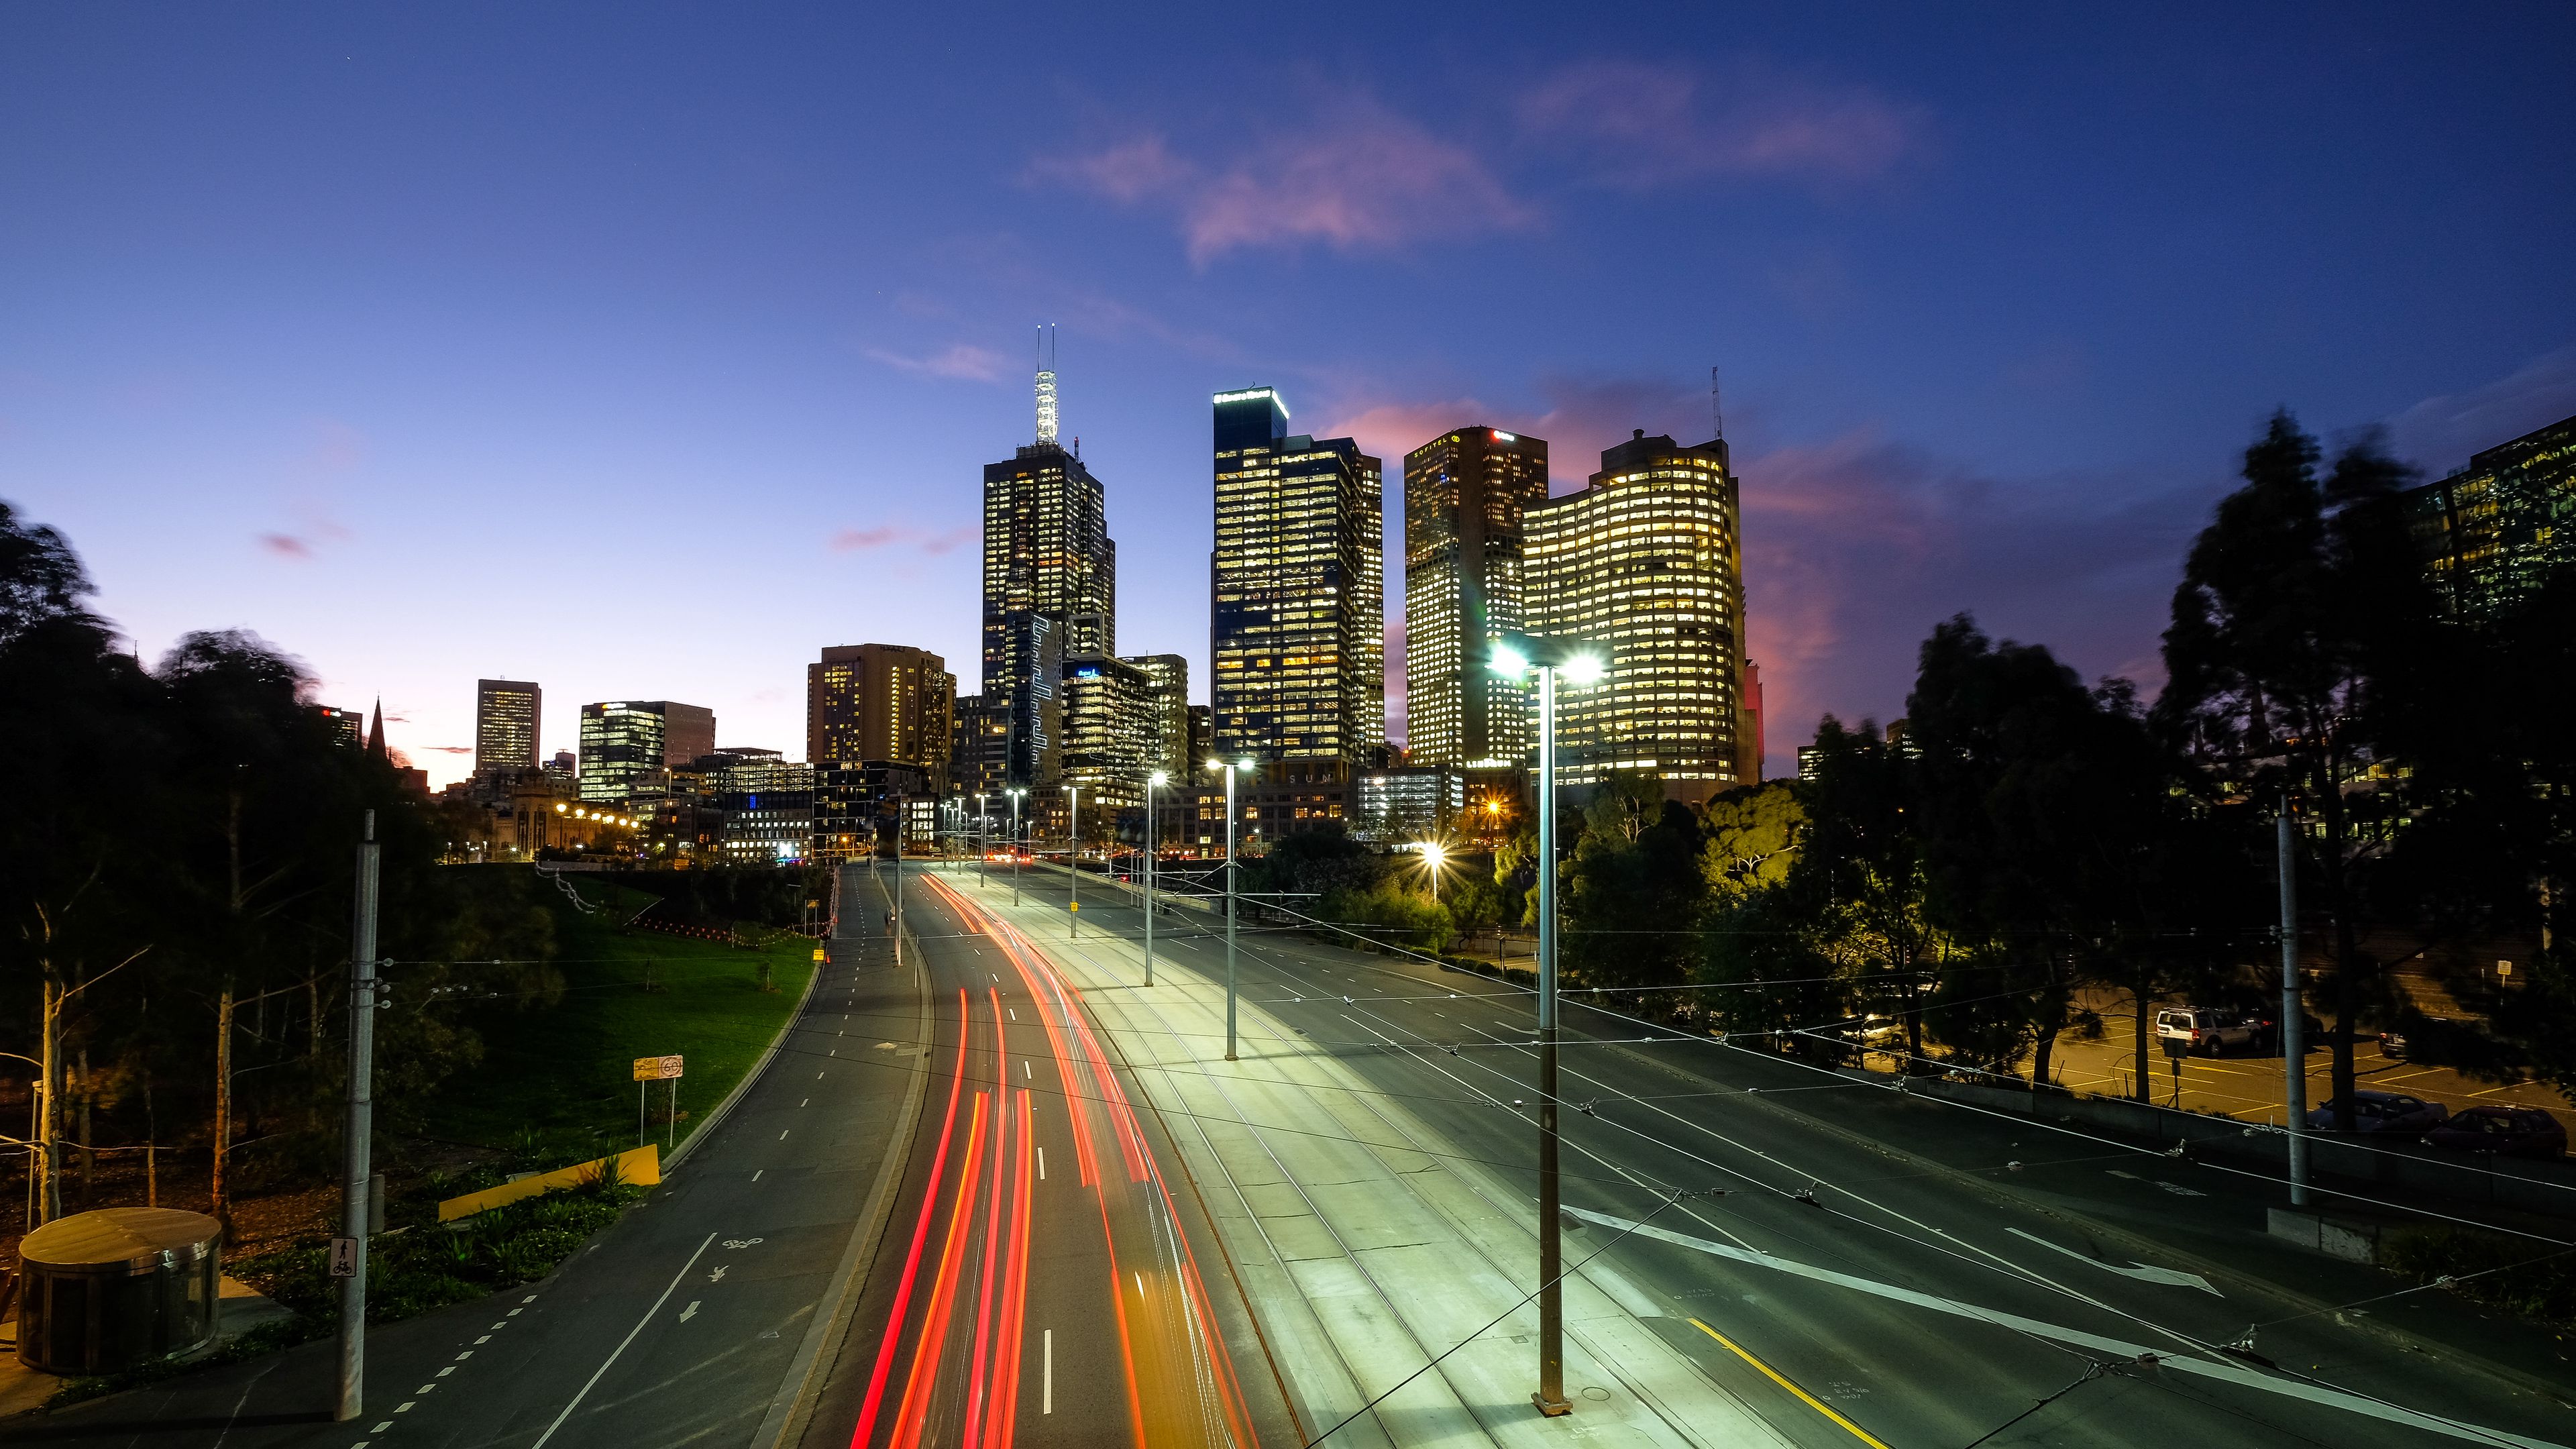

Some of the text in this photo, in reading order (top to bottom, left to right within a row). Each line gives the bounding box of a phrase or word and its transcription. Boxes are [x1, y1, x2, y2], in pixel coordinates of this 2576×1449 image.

[1414, 437, 1447, 458] SOFITEL
[1289, 773, 1331, 784] SUN
[664, 1061, 678, 1072] 60
